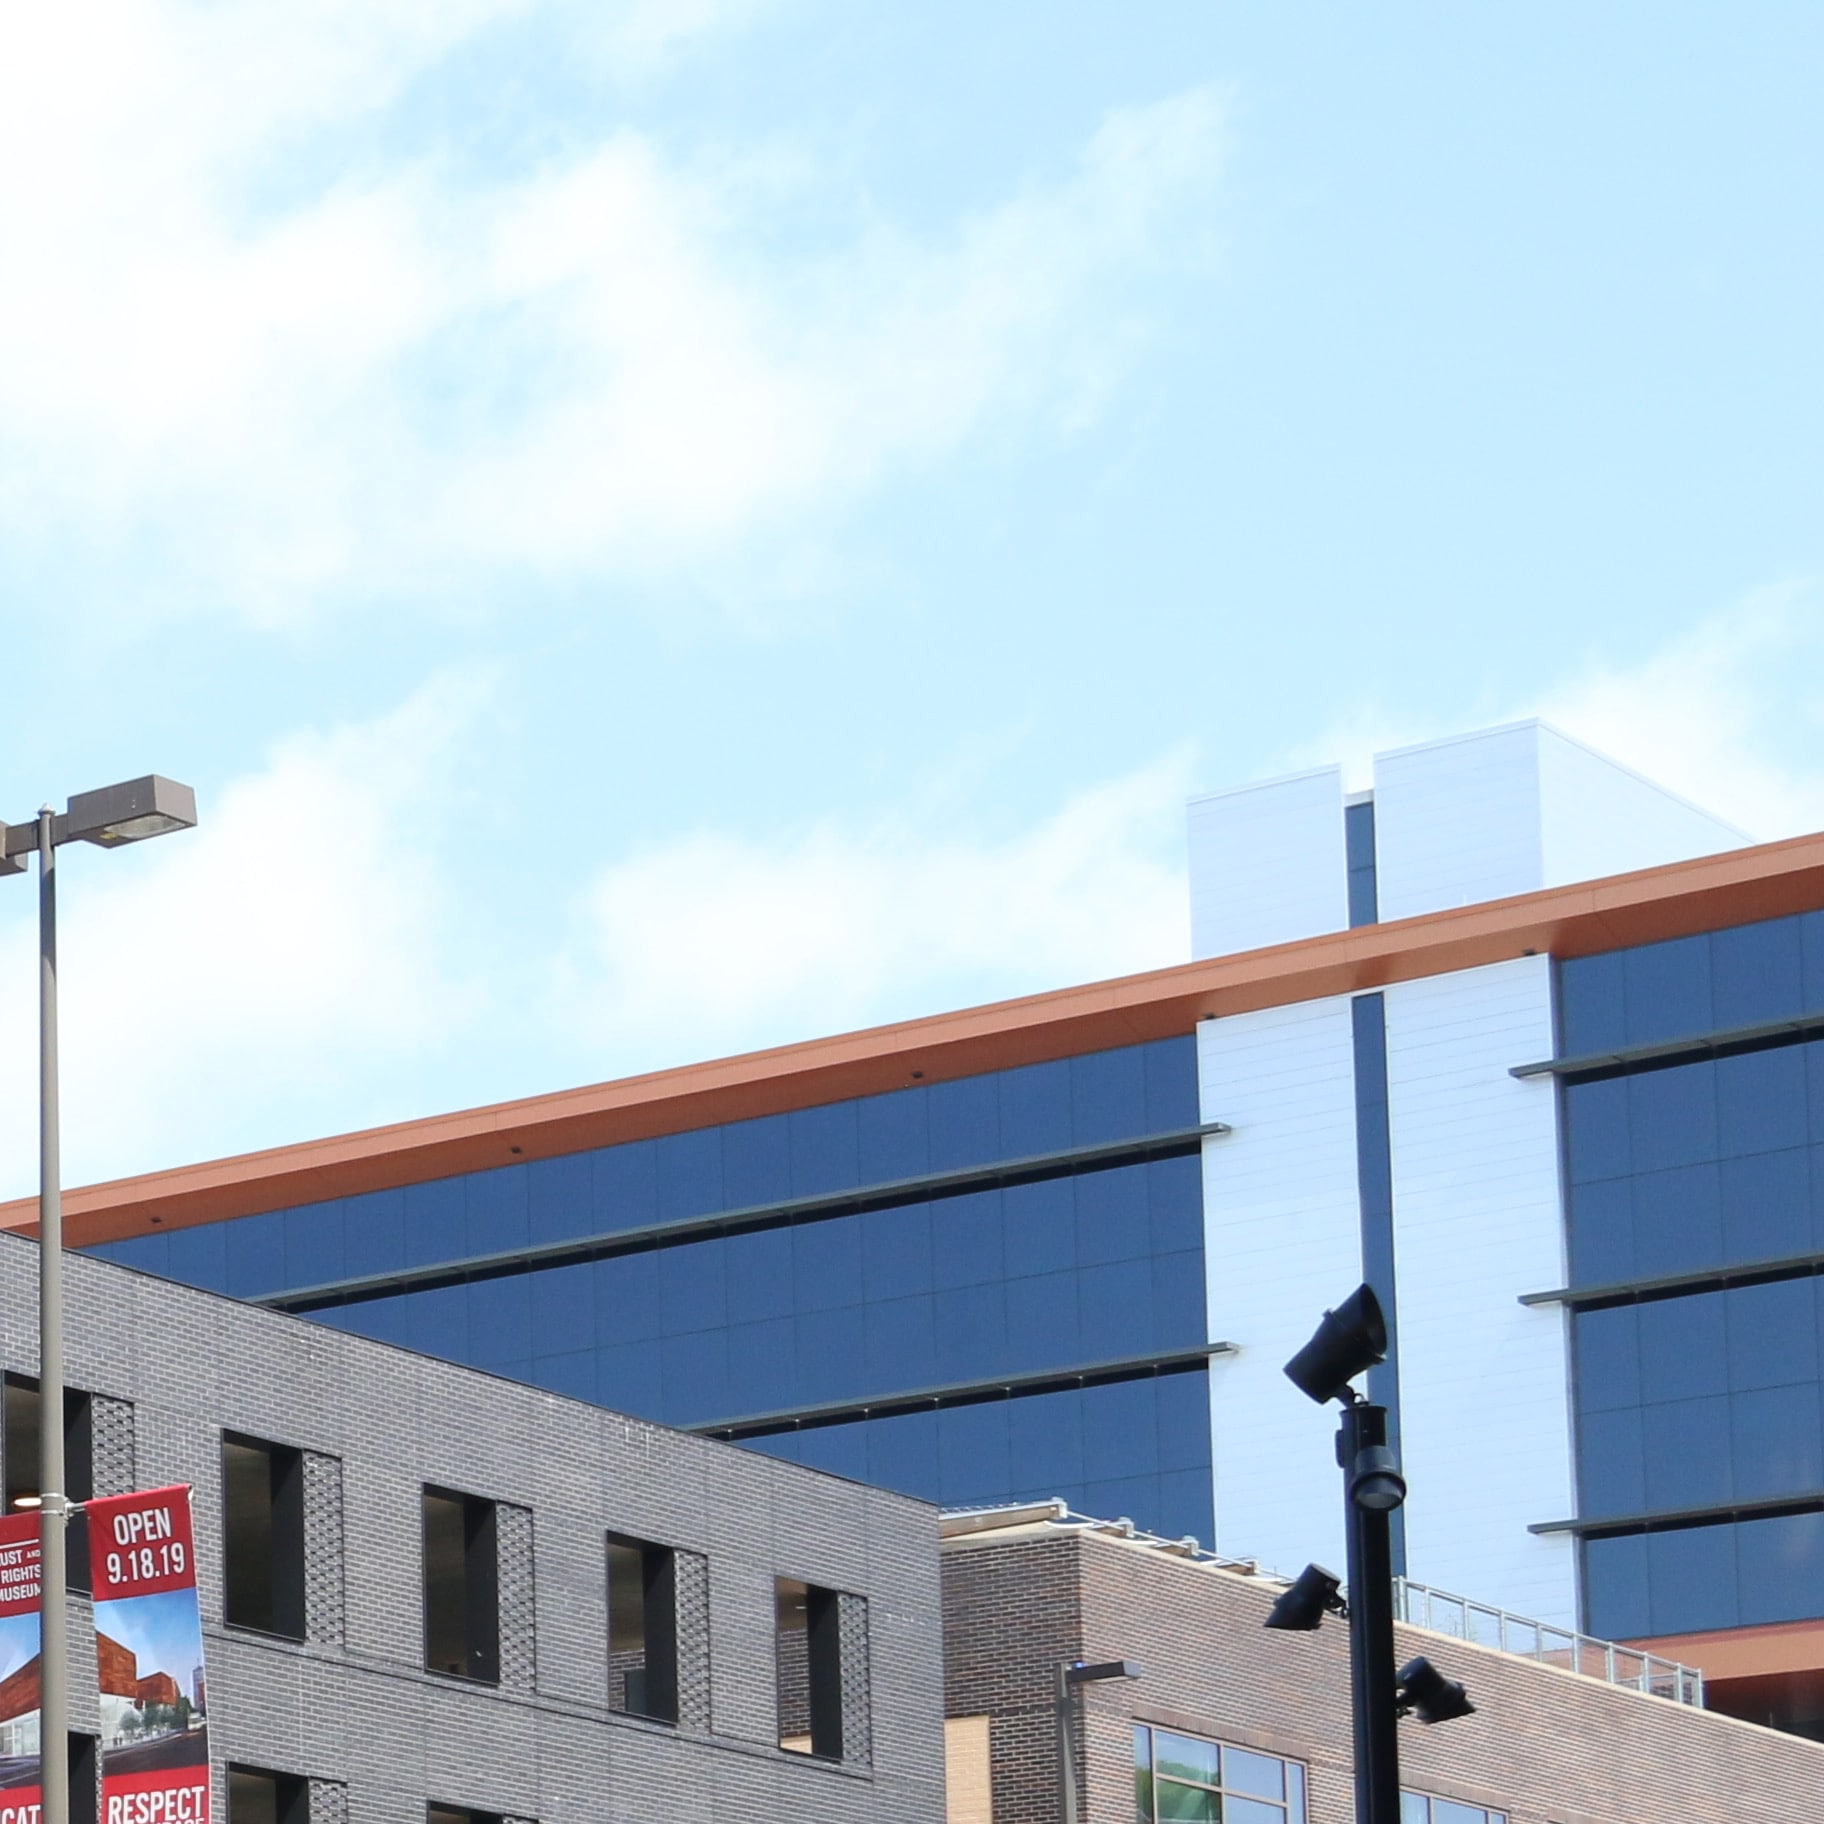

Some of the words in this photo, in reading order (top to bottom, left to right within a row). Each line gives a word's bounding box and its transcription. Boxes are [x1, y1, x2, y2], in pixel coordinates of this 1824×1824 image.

[113, 1507, 172, 1546] OPEN
[1, 1564, 41, 1584] RIGHTS
[106, 1542, 185, 1584] 9.18.19
